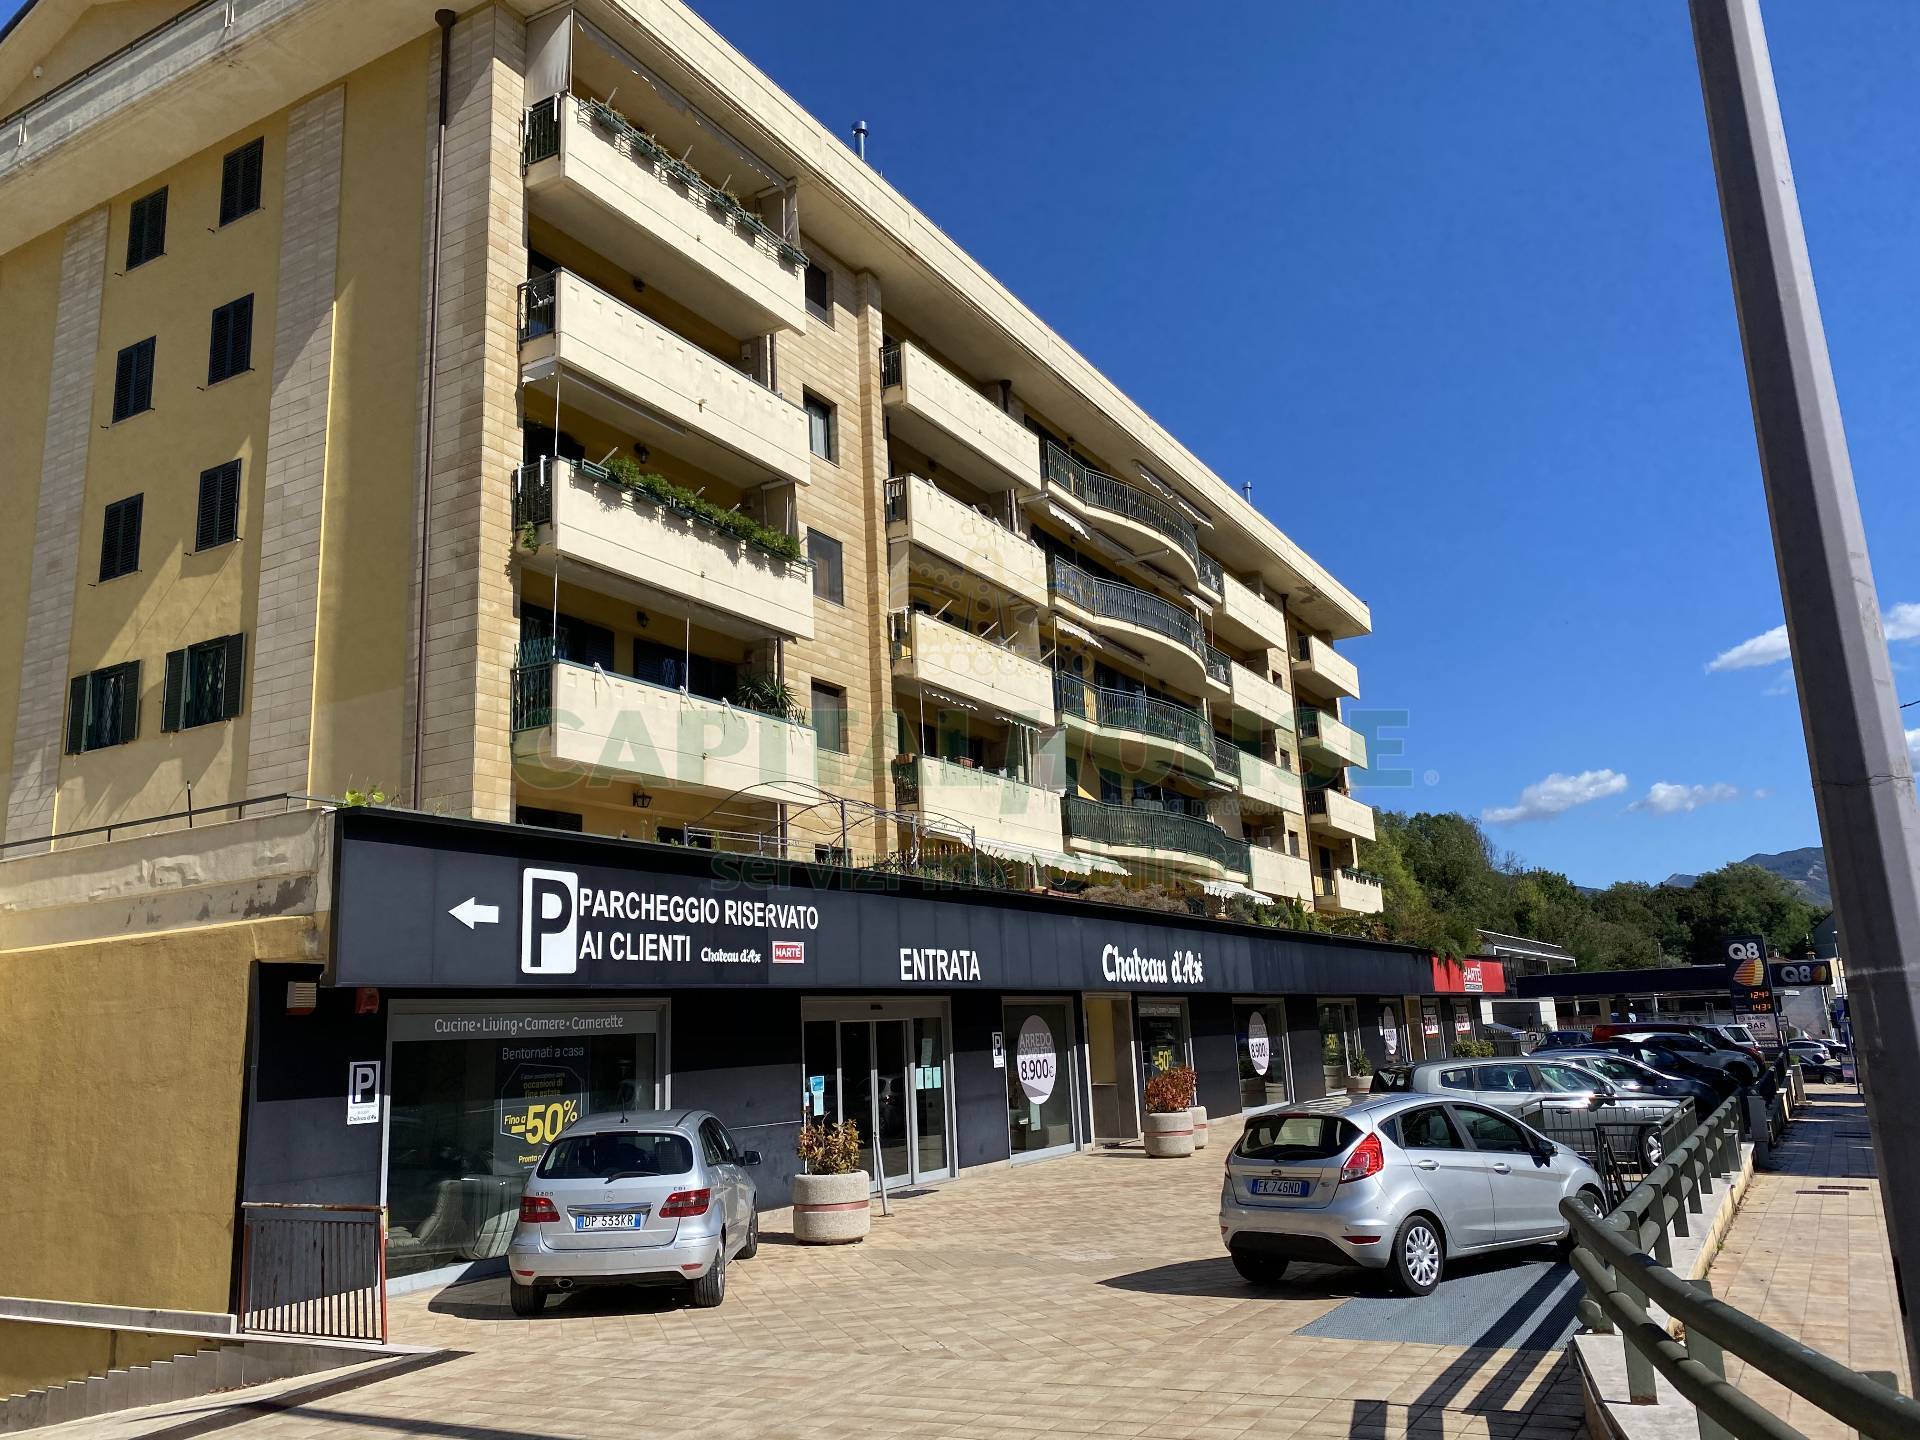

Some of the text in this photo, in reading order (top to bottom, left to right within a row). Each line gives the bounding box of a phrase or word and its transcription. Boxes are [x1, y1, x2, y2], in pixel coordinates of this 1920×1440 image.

[579, 887, 819, 931] PARCHEGGIO RISERVATO
[530, 877, 573, 968] P
[579, 930, 603, 960] AI
[609, 931, 691, 962] CLIENTI
[700, 946, 740, 964] Chateau
[1728, 942, 1760, 960] Q8
[899, 948, 982, 982] ENTRATA
[1101, 943, 1168, 984] Chateau
[1781, 965, 1812, 983] Q8
[1747, 1022, 1767, 1030] BAR
[1020, 1032, 1052, 1048] ARREDO
[502, 1045, 584, 1061] Bentornati a casa
[504, 1114, 520, 1126] Fino
[584, 1214, 634, 1227] DP 533KR
